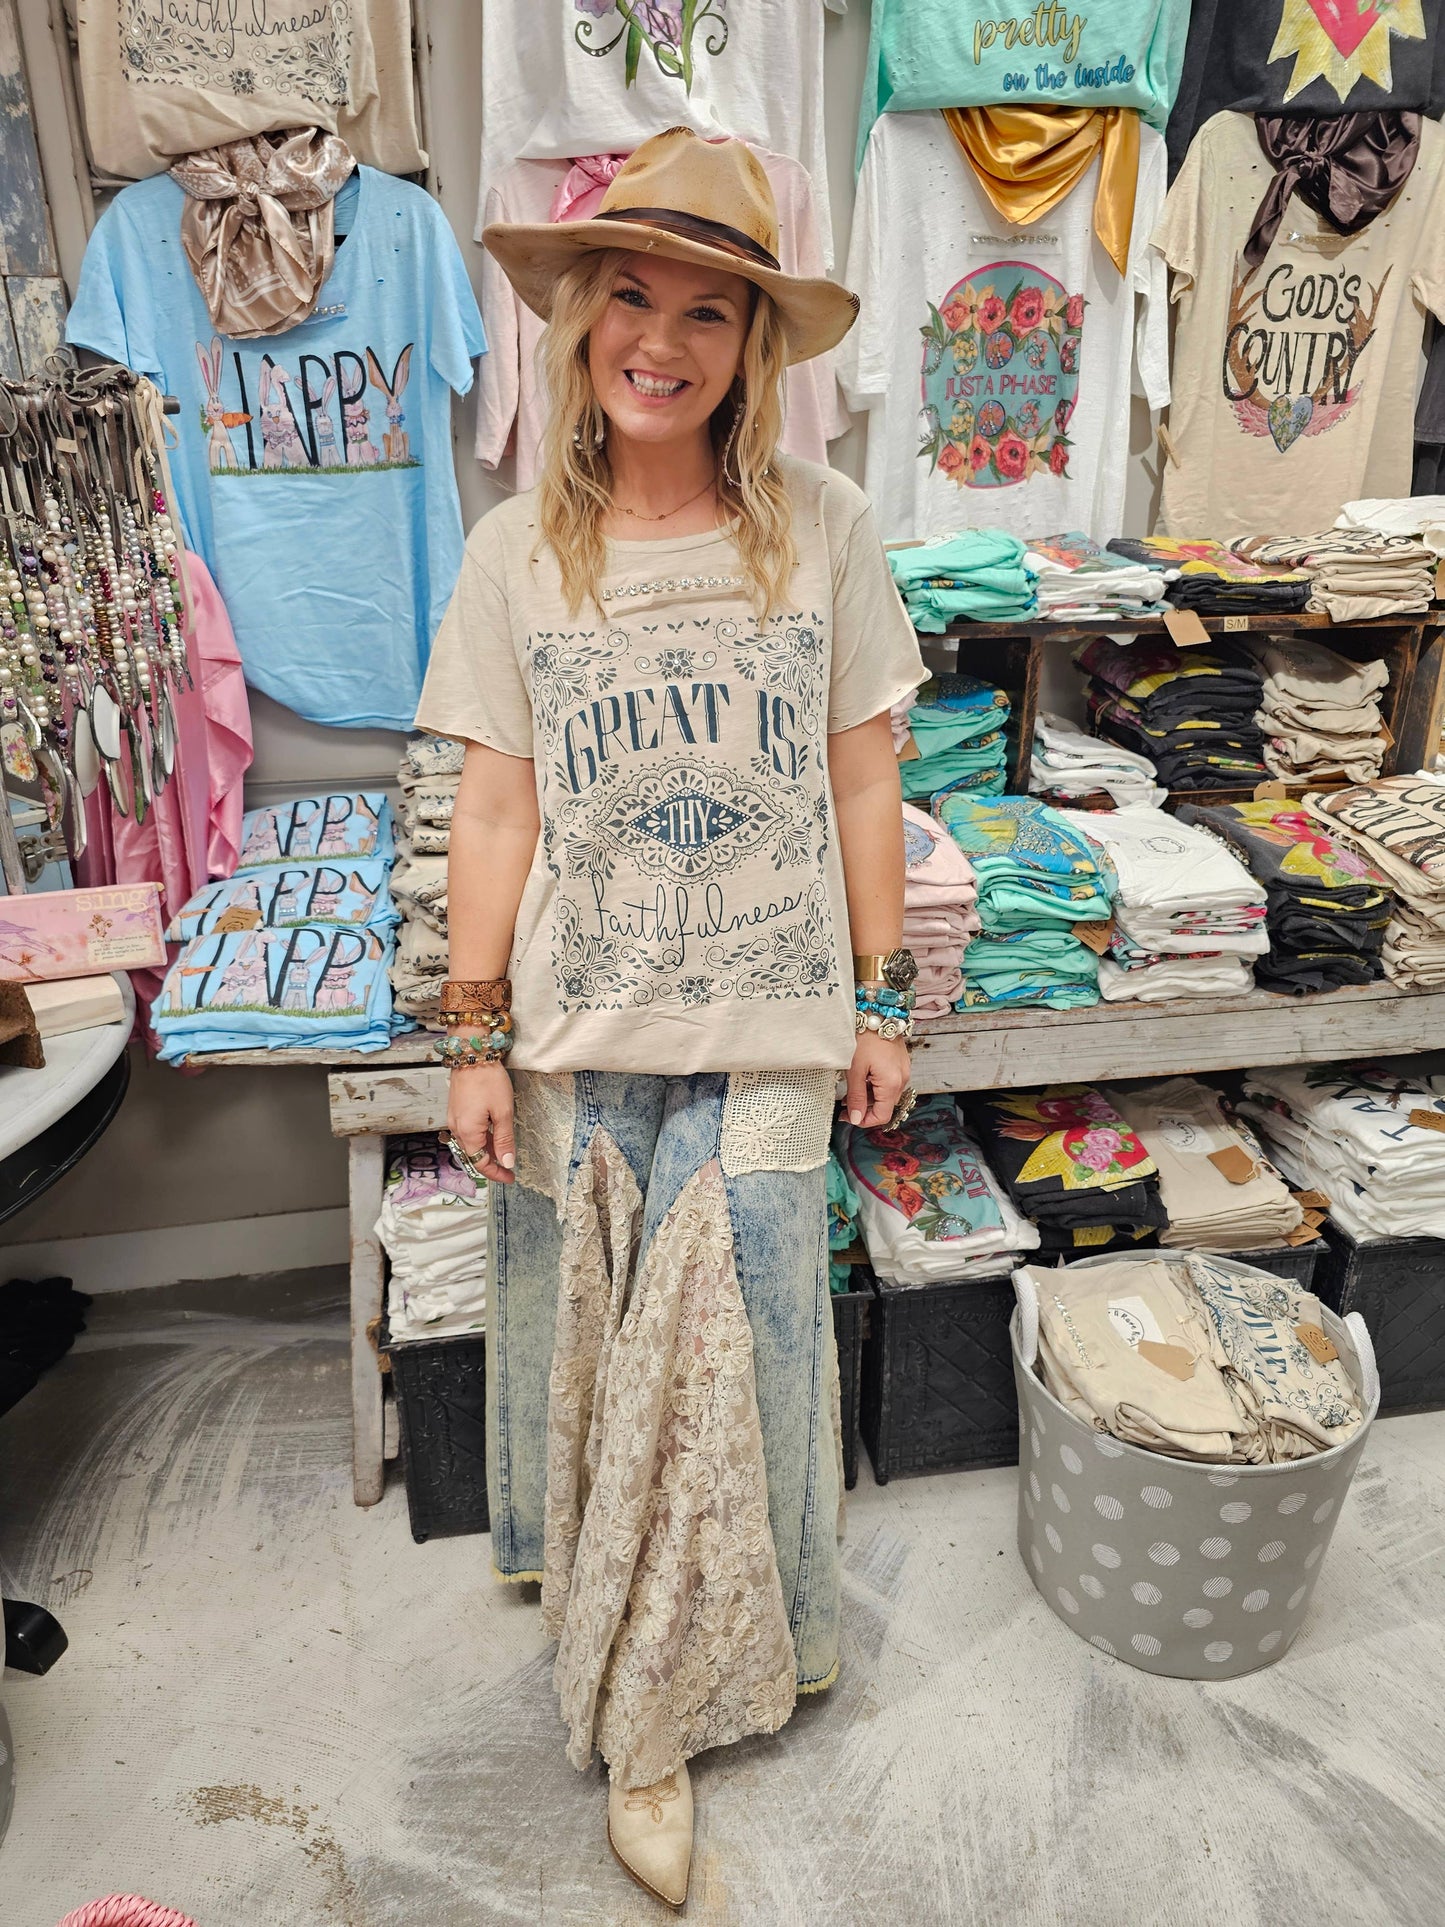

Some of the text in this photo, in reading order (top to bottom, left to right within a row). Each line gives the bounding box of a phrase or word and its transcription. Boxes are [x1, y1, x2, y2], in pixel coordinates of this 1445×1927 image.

[974, 0, 1088, 65] pretty
[1003, 54, 1135, 91] on the inside
[945, 374, 1057, 400] JUST A PHASE
[1226, 618, 1246, 630] S/M
[564, 683, 797, 794] GREAT IS
[664, 799, 713, 845] THY
[76, 889, 147, 912] sing
